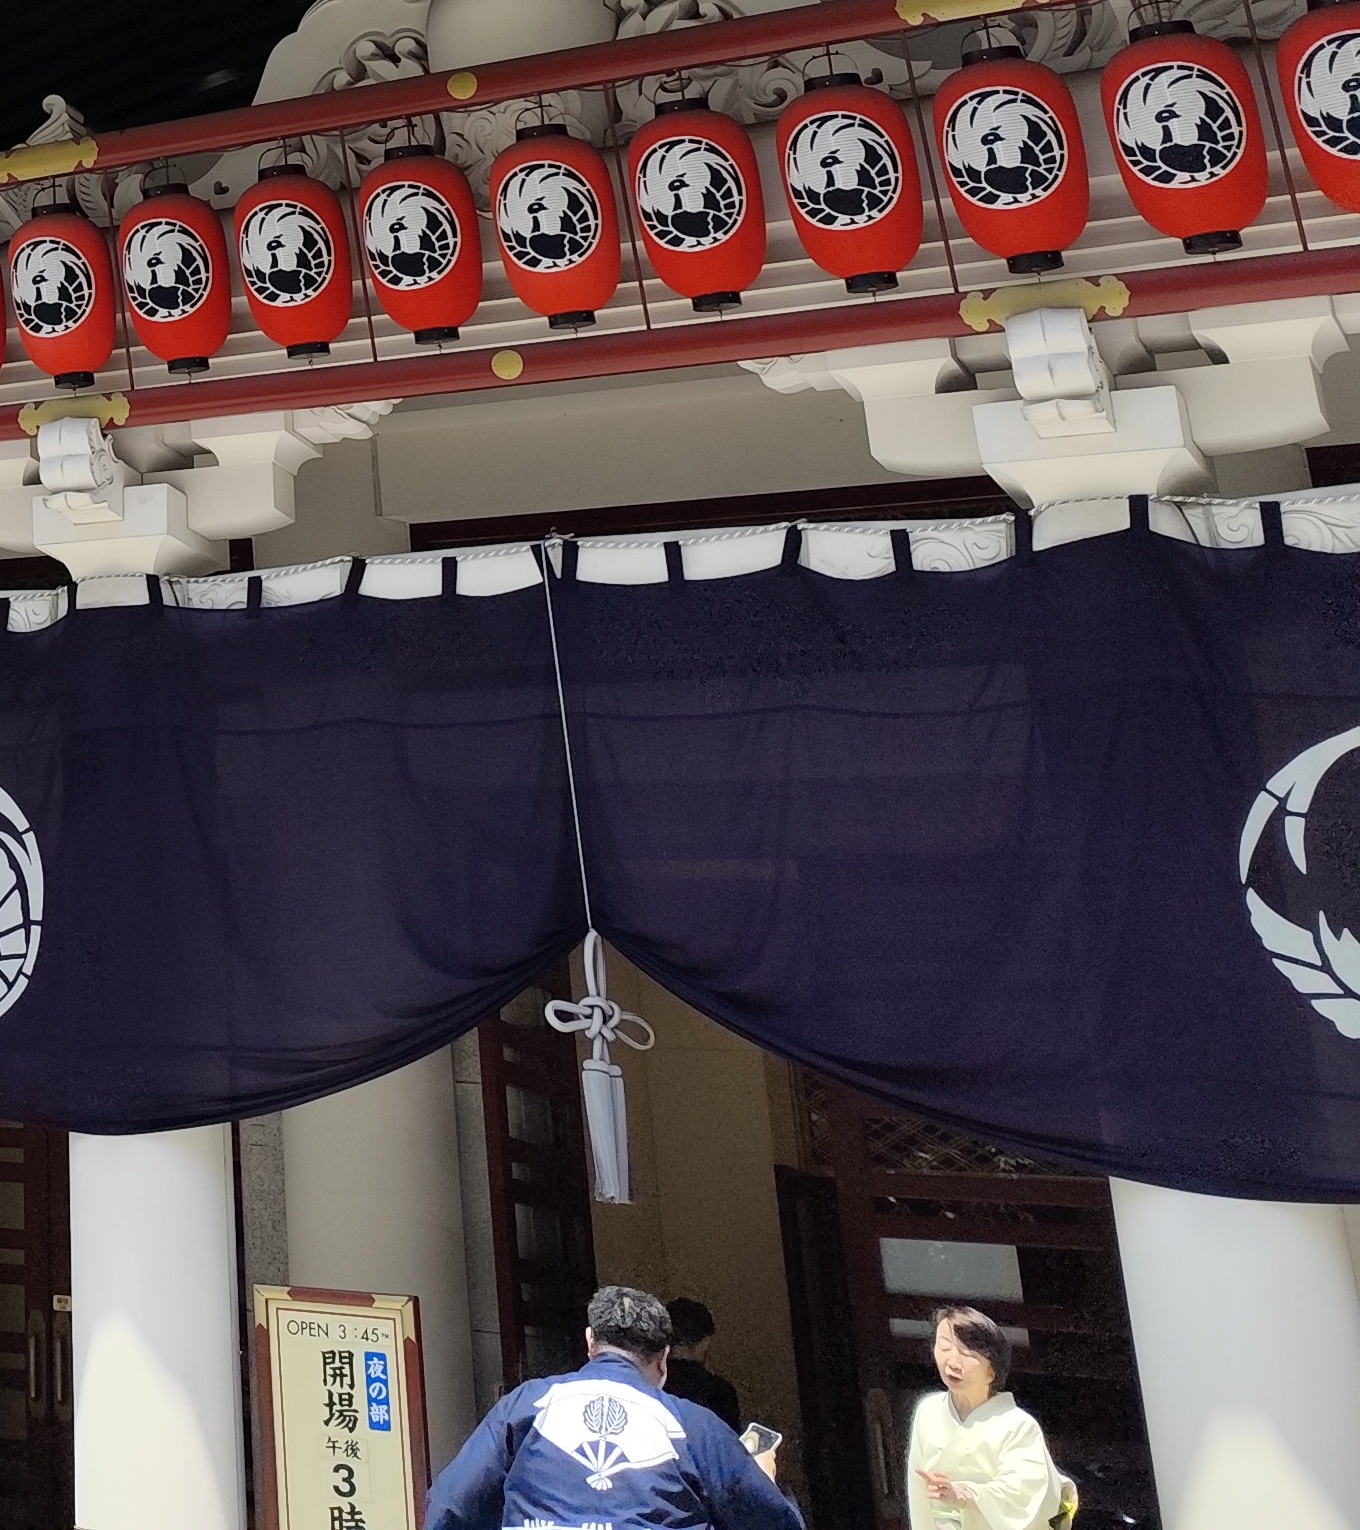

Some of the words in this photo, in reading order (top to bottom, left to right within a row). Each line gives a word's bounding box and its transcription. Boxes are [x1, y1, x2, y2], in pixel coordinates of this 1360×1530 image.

[286, 1319, 330, 1339] OPEN
[366, 1356, 389, 1425] 夜の部
